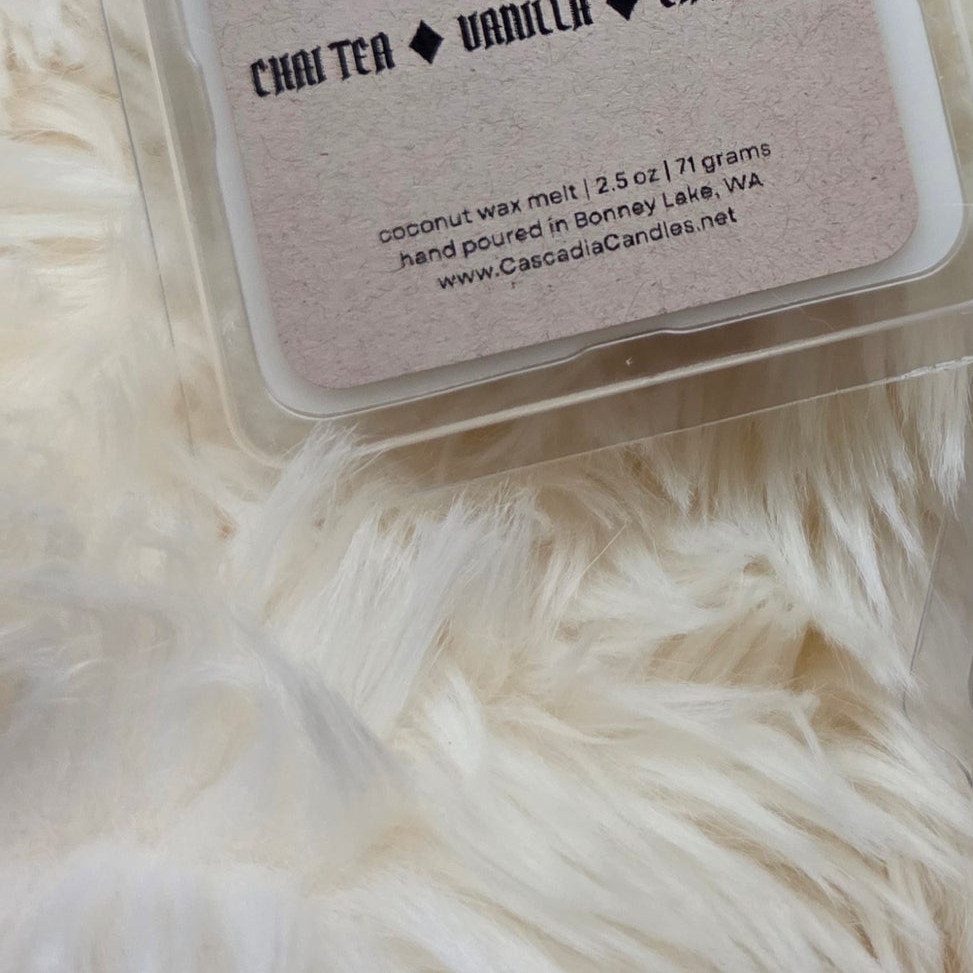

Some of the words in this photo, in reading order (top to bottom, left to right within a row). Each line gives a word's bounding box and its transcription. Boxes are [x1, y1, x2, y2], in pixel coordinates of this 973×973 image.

[250, 45, 328, 97] CHAI
[327, 31, 396, 81] TEA
[379, 208, 473, 244] coconut
[476, 198, 522, 221] wax
[527, 184, 578, 210] melt
[595, 171, 629, 195] 2.5
[633, 167, 660, 186] oz
[675, 155, 697, 175] 71
[701, 142, 772, 174] grams
[400, 239, 457, 269] hand
[461, 219, 543, 258] poured
[549, 217, 569, 234] in
[574, 197, 656, 229] Bonney
[662, 184, 721, 209] Lake,
[724, 172, 764, 194] WA
[437, 206, 738, 290] www.CascadiaCandles.net
